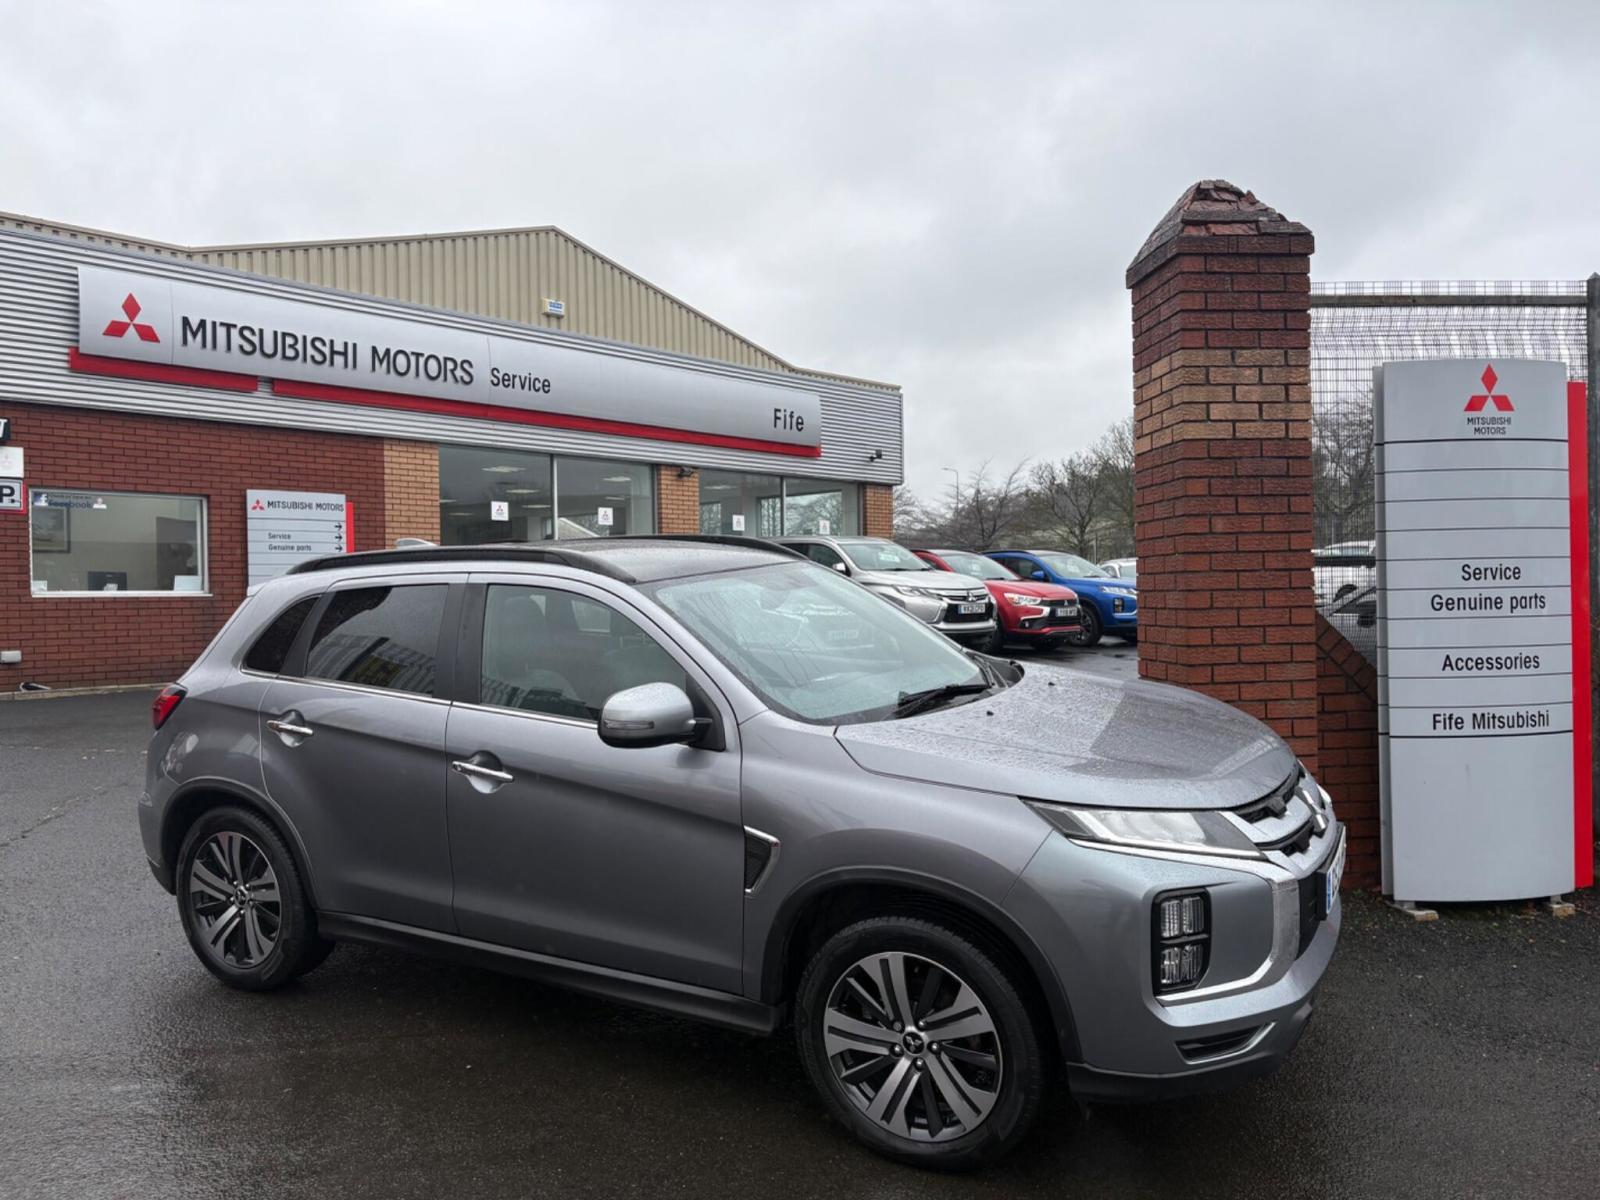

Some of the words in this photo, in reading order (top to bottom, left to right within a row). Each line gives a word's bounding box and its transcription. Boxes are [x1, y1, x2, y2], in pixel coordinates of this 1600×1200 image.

[182, 316, 357, 370] MITSUBISHI
[371, 345, 474, 385] MOTORS
[490, 368, 552, 394] Service
[773, 408, 805, 432] Fife
[1466, 416, 1512, 426] MITSUBISHI
[1473, 427, 1506, 435] MOTORS
[267, 500, 313, 511] MITSUBISHI
[315, 503, 344, 512] MOTORS
[268, 532, 291, 540] Service
[296, 544, 312, 553] parts
[1461, 563, 1522, 582] Service
[1430, 593, 1504, 612] Genuine
[1510, 592, 1546, 614] parts
[1442, 653, 1540, 672] Accessories
[1432, 713, 1465, 731] Fife
[1471, 709, 1551, 730] Mitsubishi
